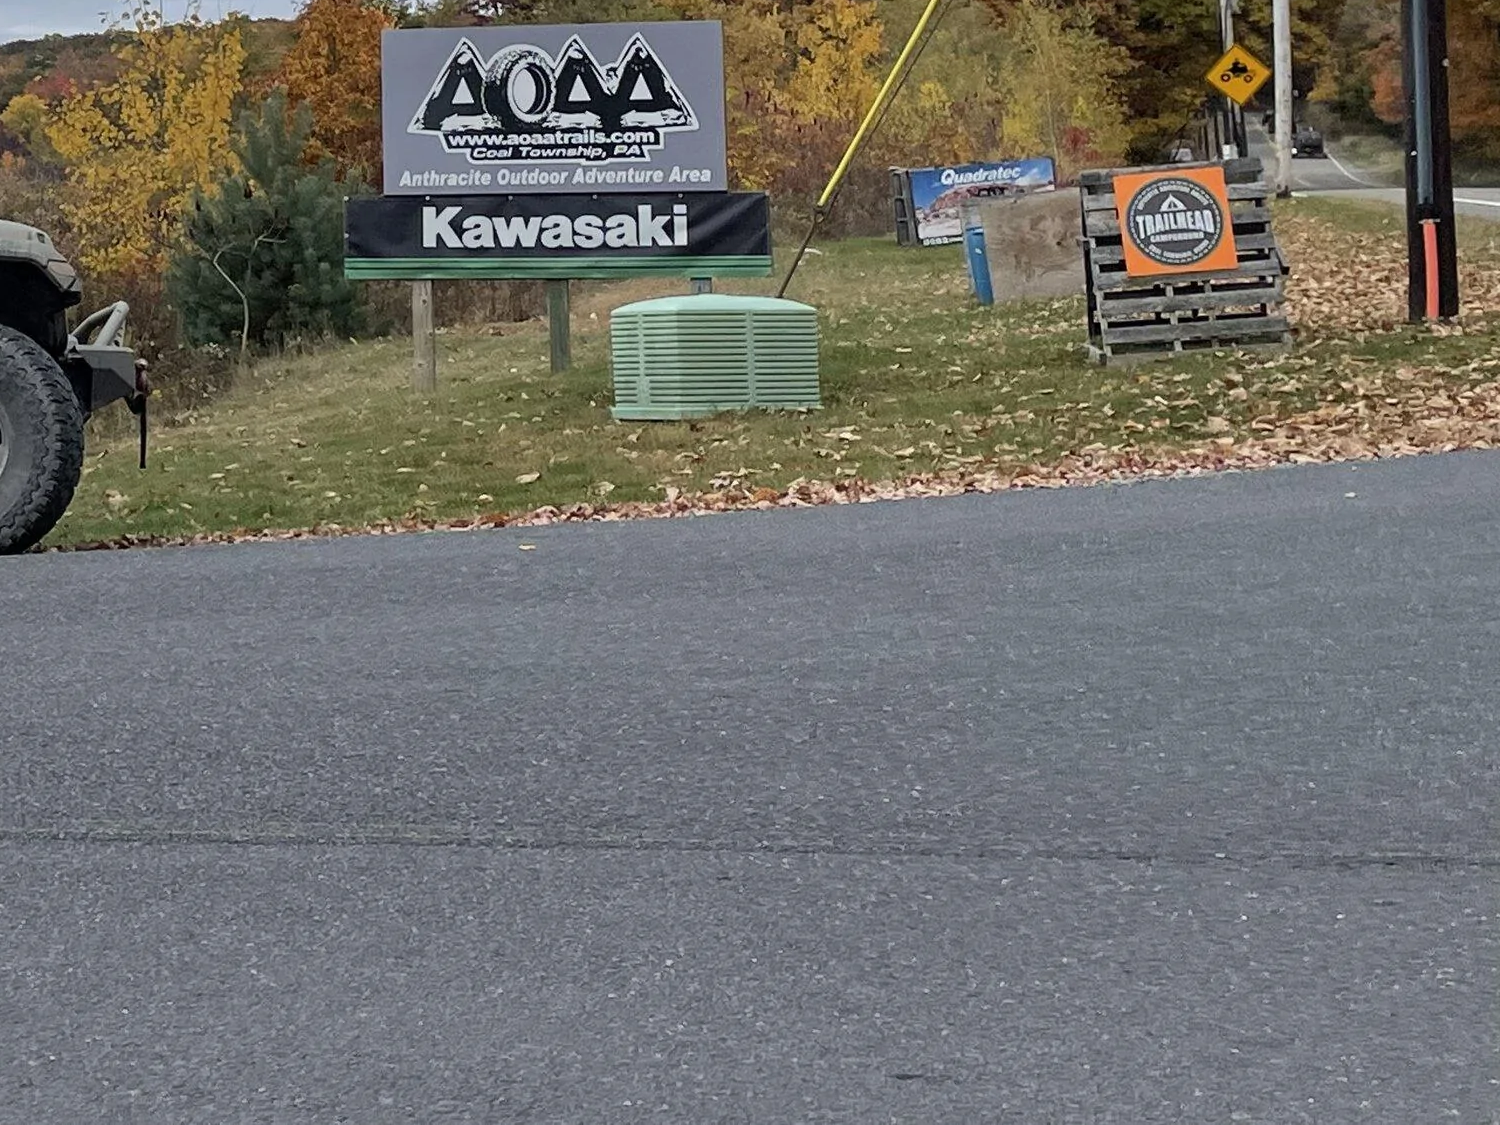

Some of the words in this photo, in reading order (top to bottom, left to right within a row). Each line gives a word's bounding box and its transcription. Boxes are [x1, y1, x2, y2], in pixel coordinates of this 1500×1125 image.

[408, 34, 697, 132] AOAA
[448, 129, 655, 146] www.aoaatrails.com
[472, 147, 513, 159] Coal
[519, 145, 607, 159] Township,
[613, 144, 642, 156] PA
[399, 170, 492, 187] Anthracite
[497, 168, 569, 185] Outdoor
[571, 166, 665, 184] Adventure
[668, 165, 712, 182] Area
[940, 166, 1021, 186] Quadratec
[421, 203, 688, 249] Kawasaki
[1135, 209, 1215, 239] TRAILHEAD
